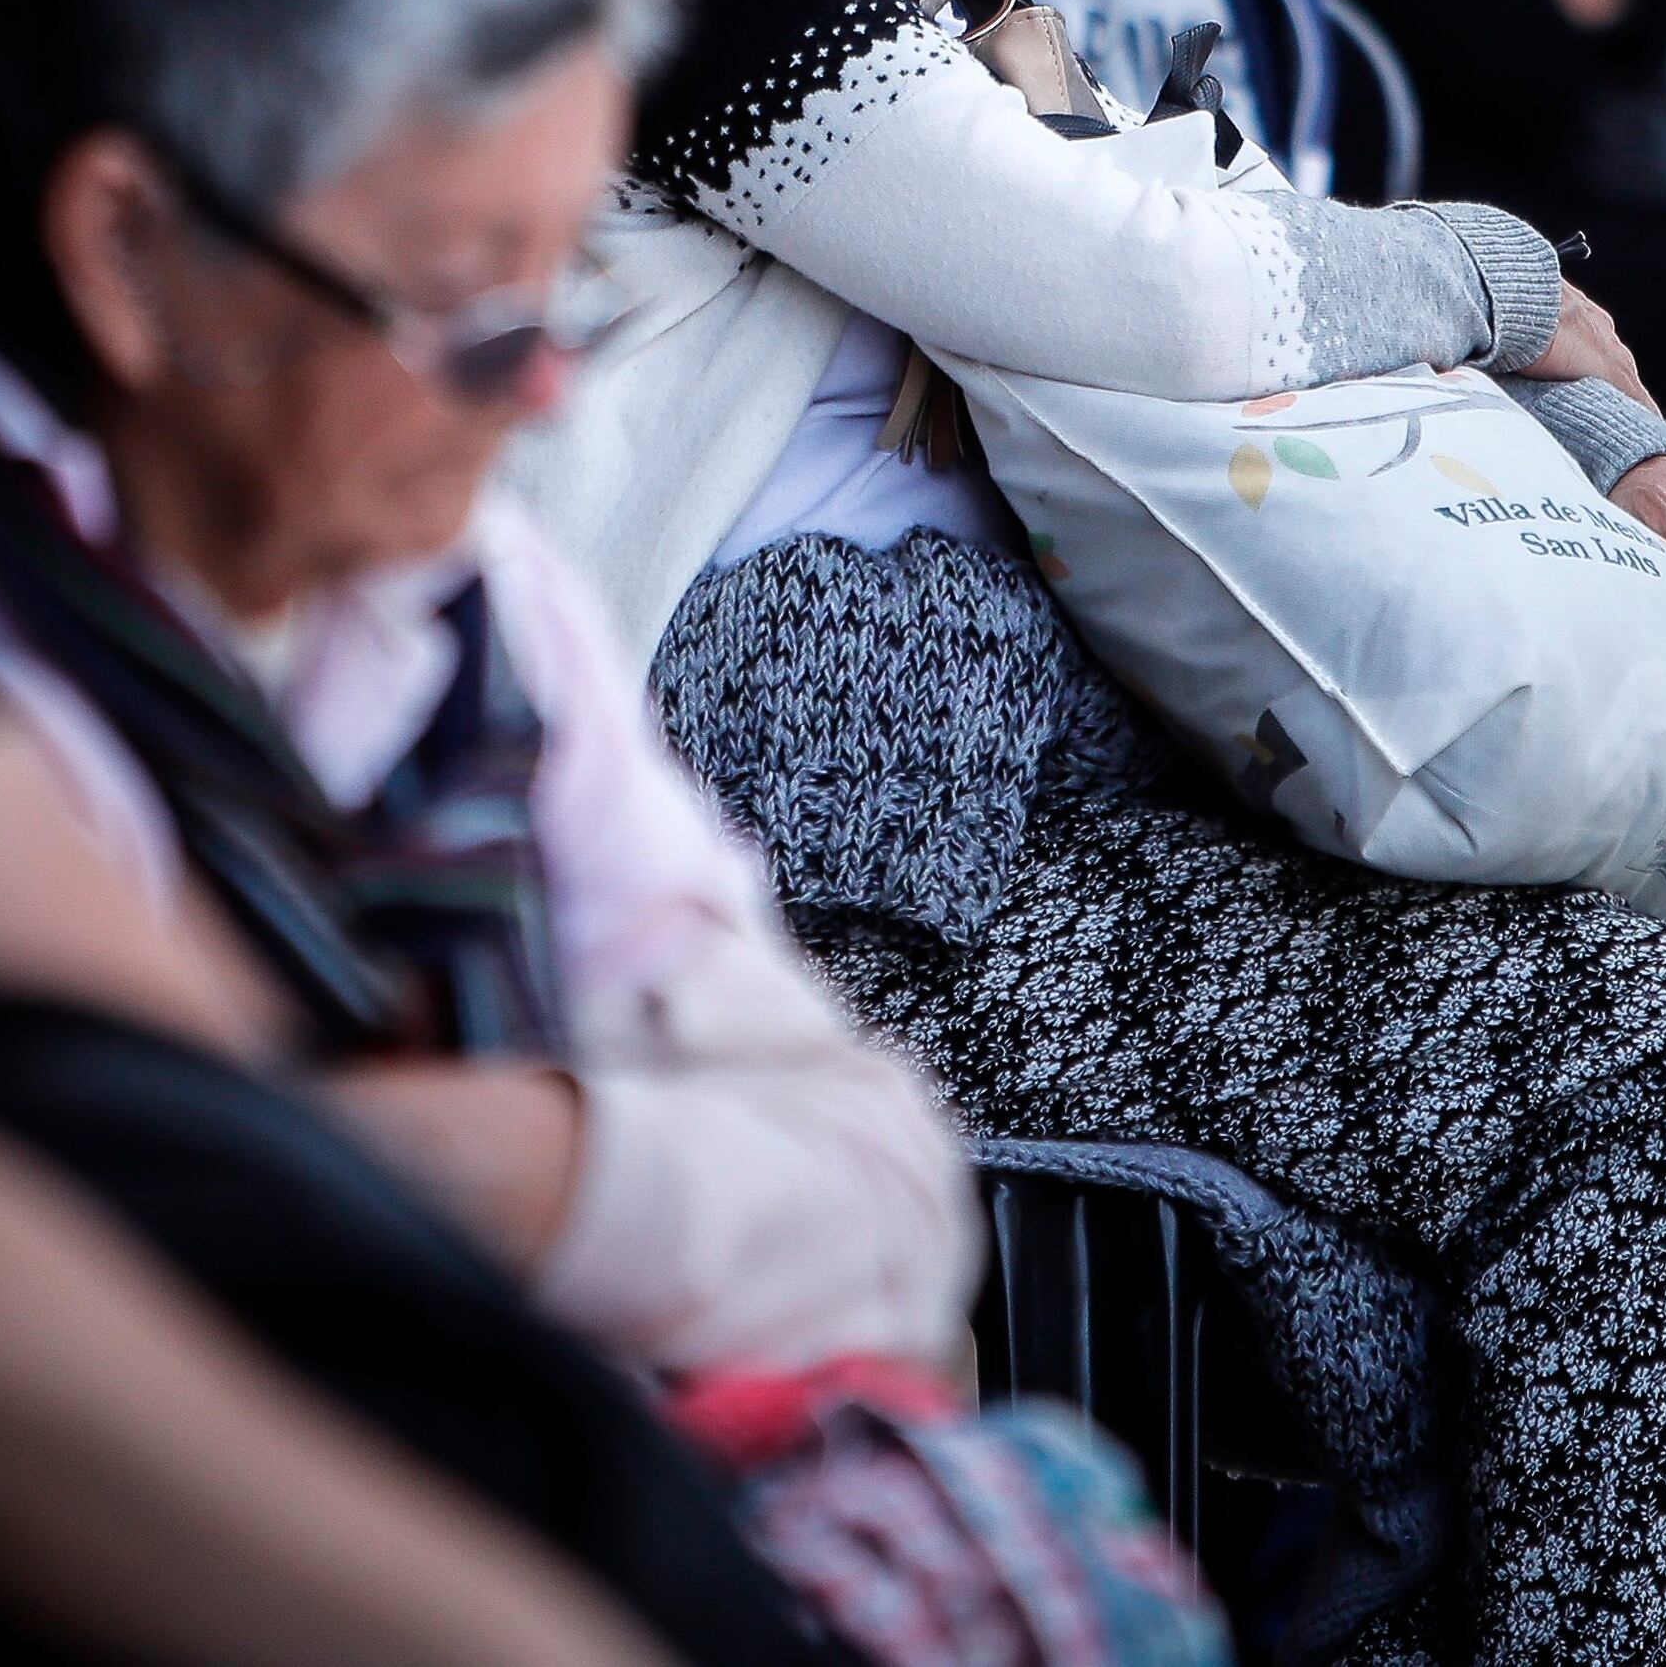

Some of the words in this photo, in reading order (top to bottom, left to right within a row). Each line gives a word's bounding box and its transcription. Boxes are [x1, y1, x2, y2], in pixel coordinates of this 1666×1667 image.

[1434, 497, 1536, 527] Villa
[1541, 497, 1582, 523] de
[1520, 532, 1593, 560] San
[1590, 536, 1661, 577] Luis
